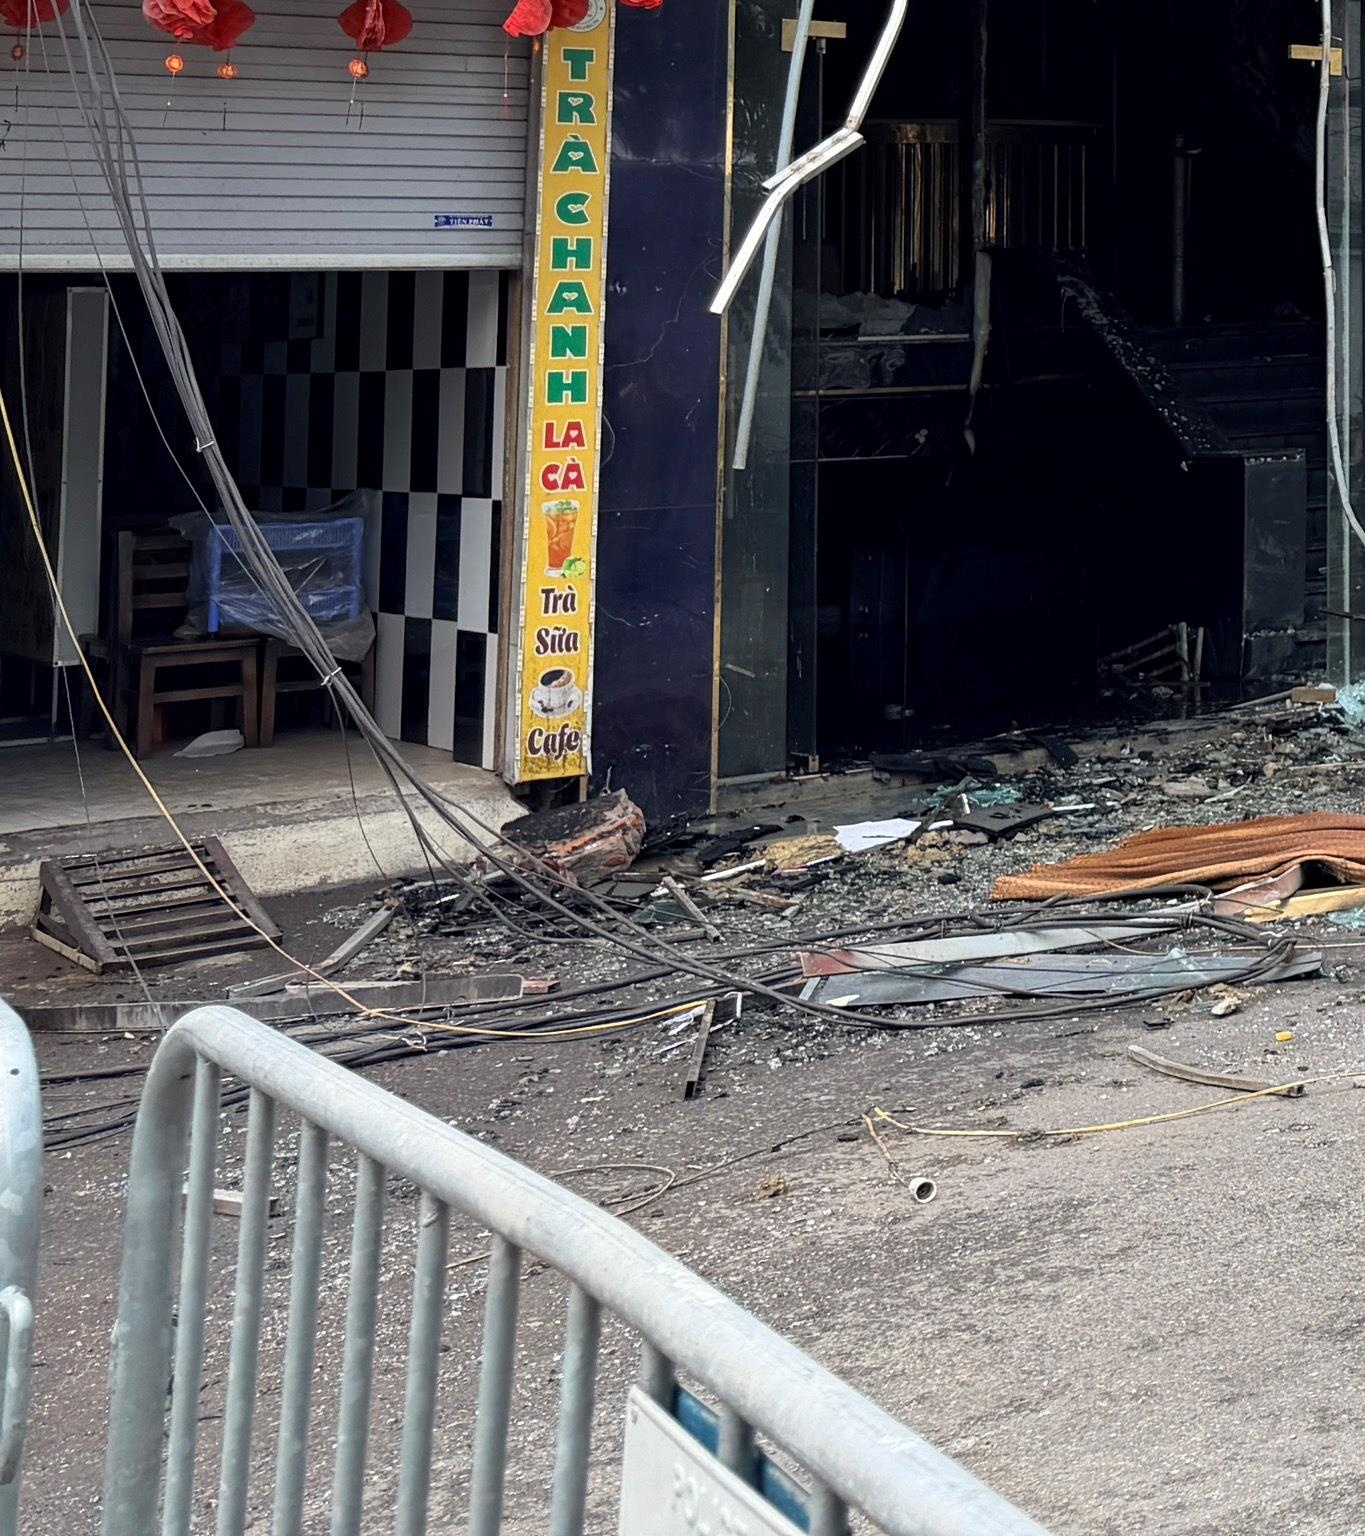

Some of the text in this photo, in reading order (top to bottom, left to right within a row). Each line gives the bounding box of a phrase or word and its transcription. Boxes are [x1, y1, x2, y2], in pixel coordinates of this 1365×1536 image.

[550, 47, 600, 174] TRÀ
[545, 192, 595, 405] CHANH
[541, 420, 586, 451] LA
[540, 456, 586, 492] CÀ
[540, 585, 577, 616] Trà
[534, 624, 580, 657] Sữa
[526, 724, 582, 762] Cafe
